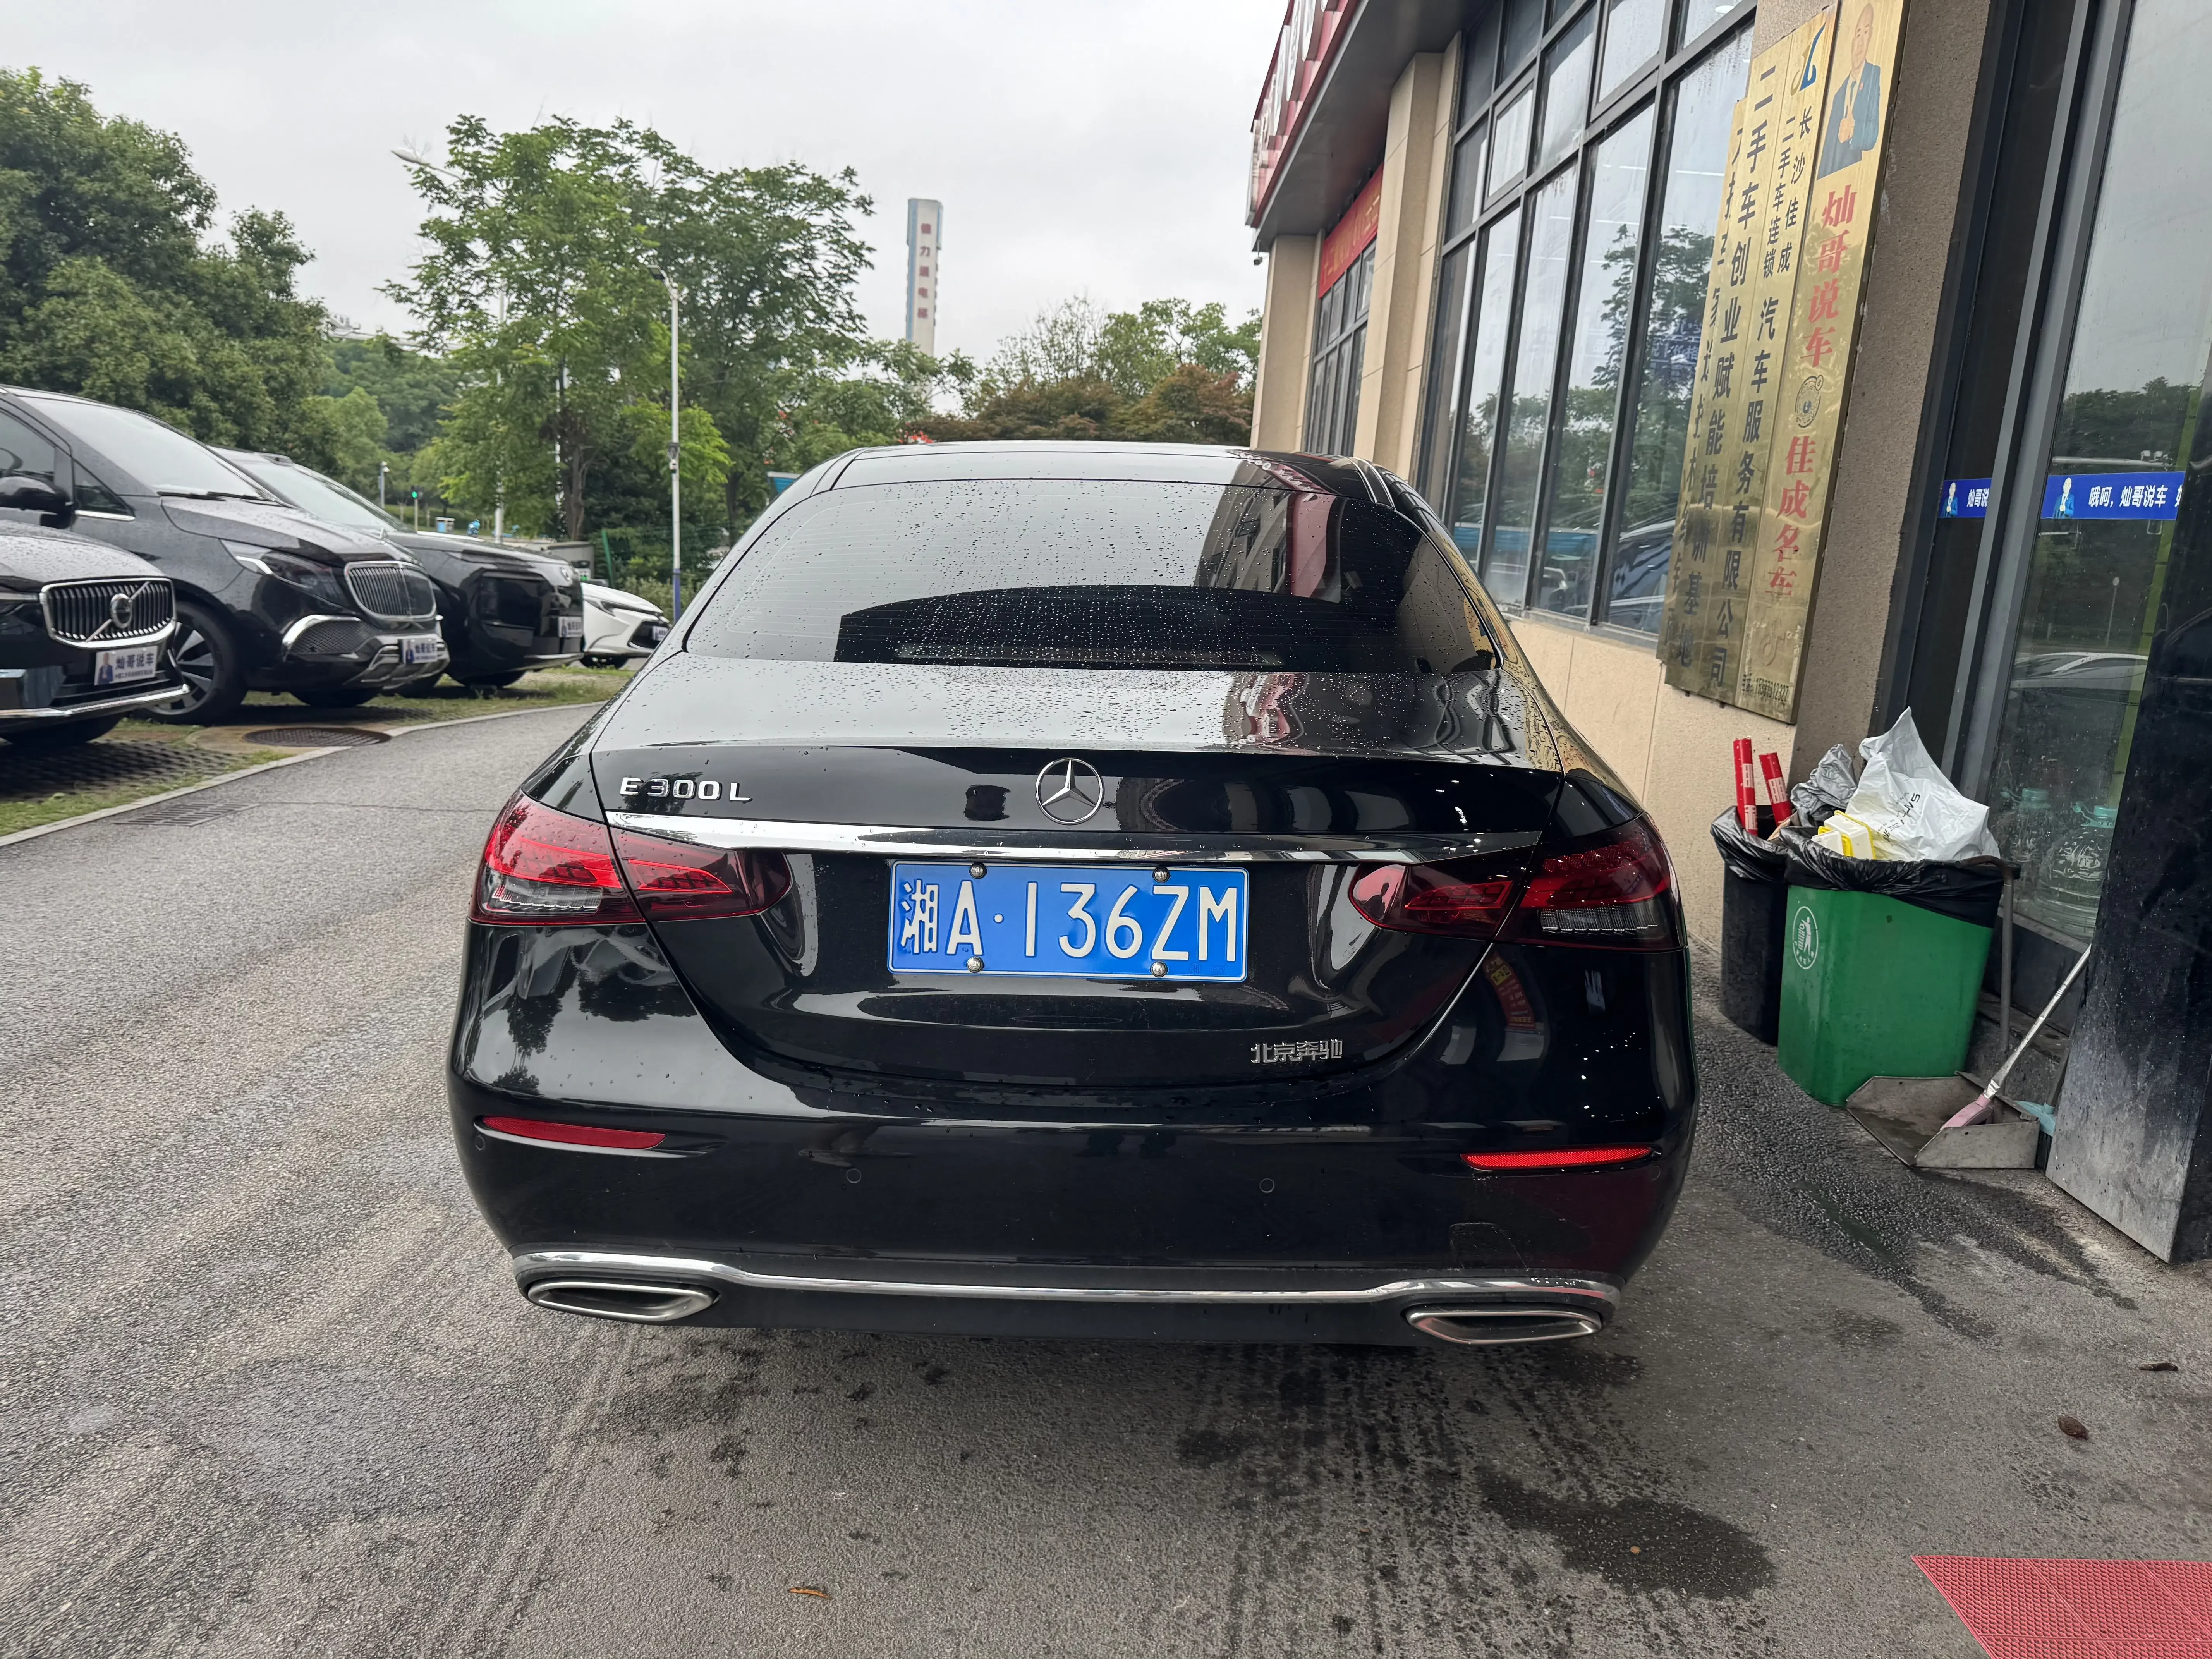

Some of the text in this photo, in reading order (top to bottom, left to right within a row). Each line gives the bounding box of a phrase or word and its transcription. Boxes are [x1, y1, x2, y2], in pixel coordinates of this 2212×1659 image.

[1763, 116, 1796, 279] 二手车连锁
[1777, 106, 1813, 273] 长沙佳成
[1800, 184, 1857, 368] 灿哥说车
[1710, 296, 1779, 687] 汽车服务有限公司
[1765, 435, 1816, 596] 佳成名车
[1966, 488, 1989, 507] 灿哥说
[1250, 1038, 1343, 1064] 北京奔驰
